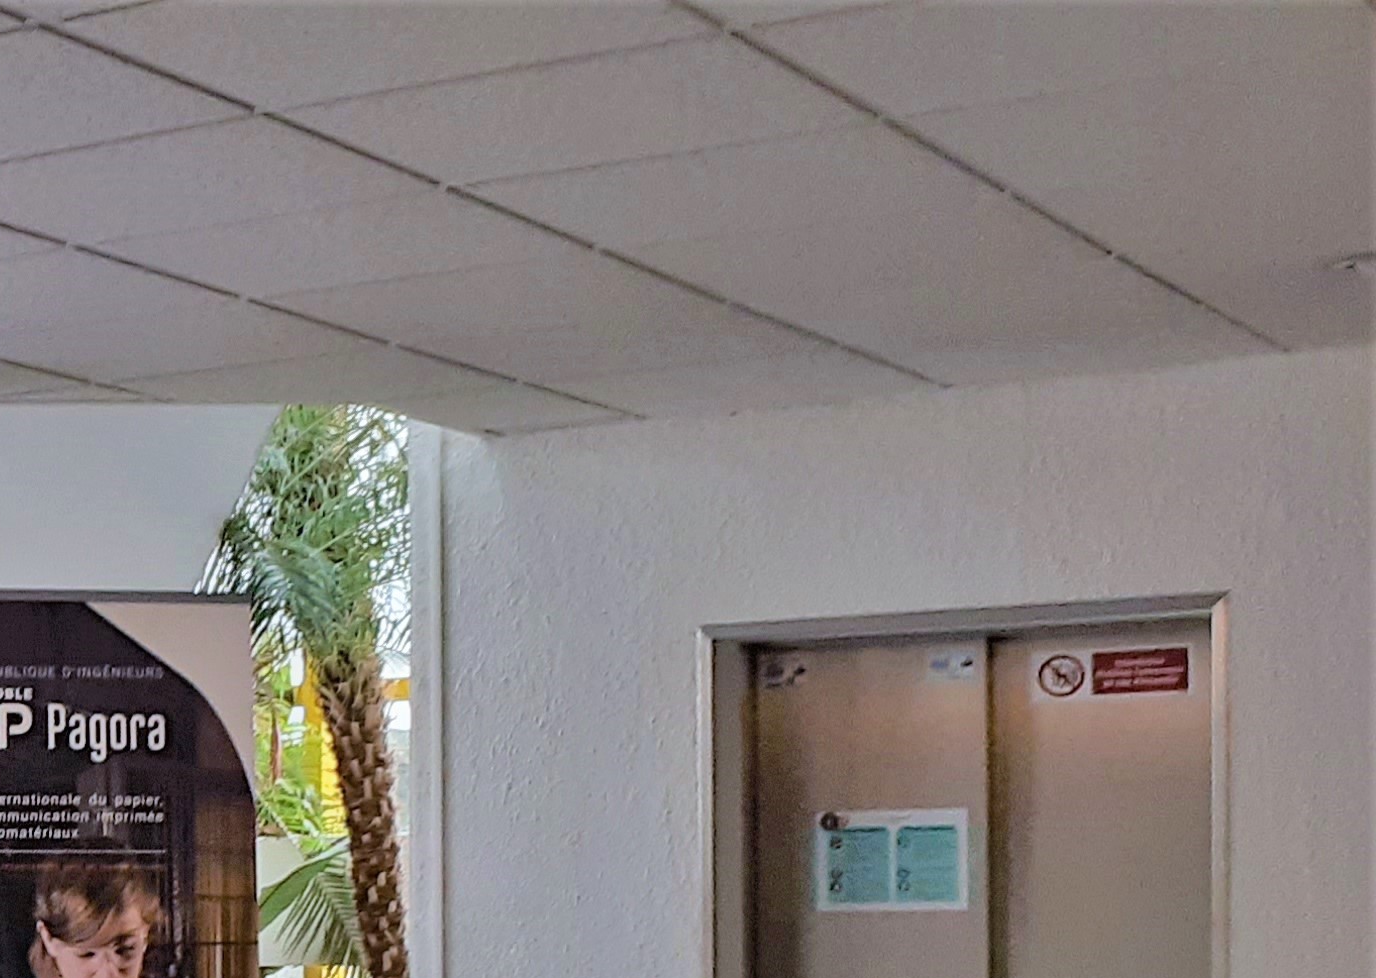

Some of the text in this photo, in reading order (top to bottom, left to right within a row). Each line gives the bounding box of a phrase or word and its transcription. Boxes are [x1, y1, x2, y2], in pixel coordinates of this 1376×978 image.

[48, 703, 166, 763] Pagora
[88, 792, 107, 806] du
[96, 809, 165, 825] imprimée
